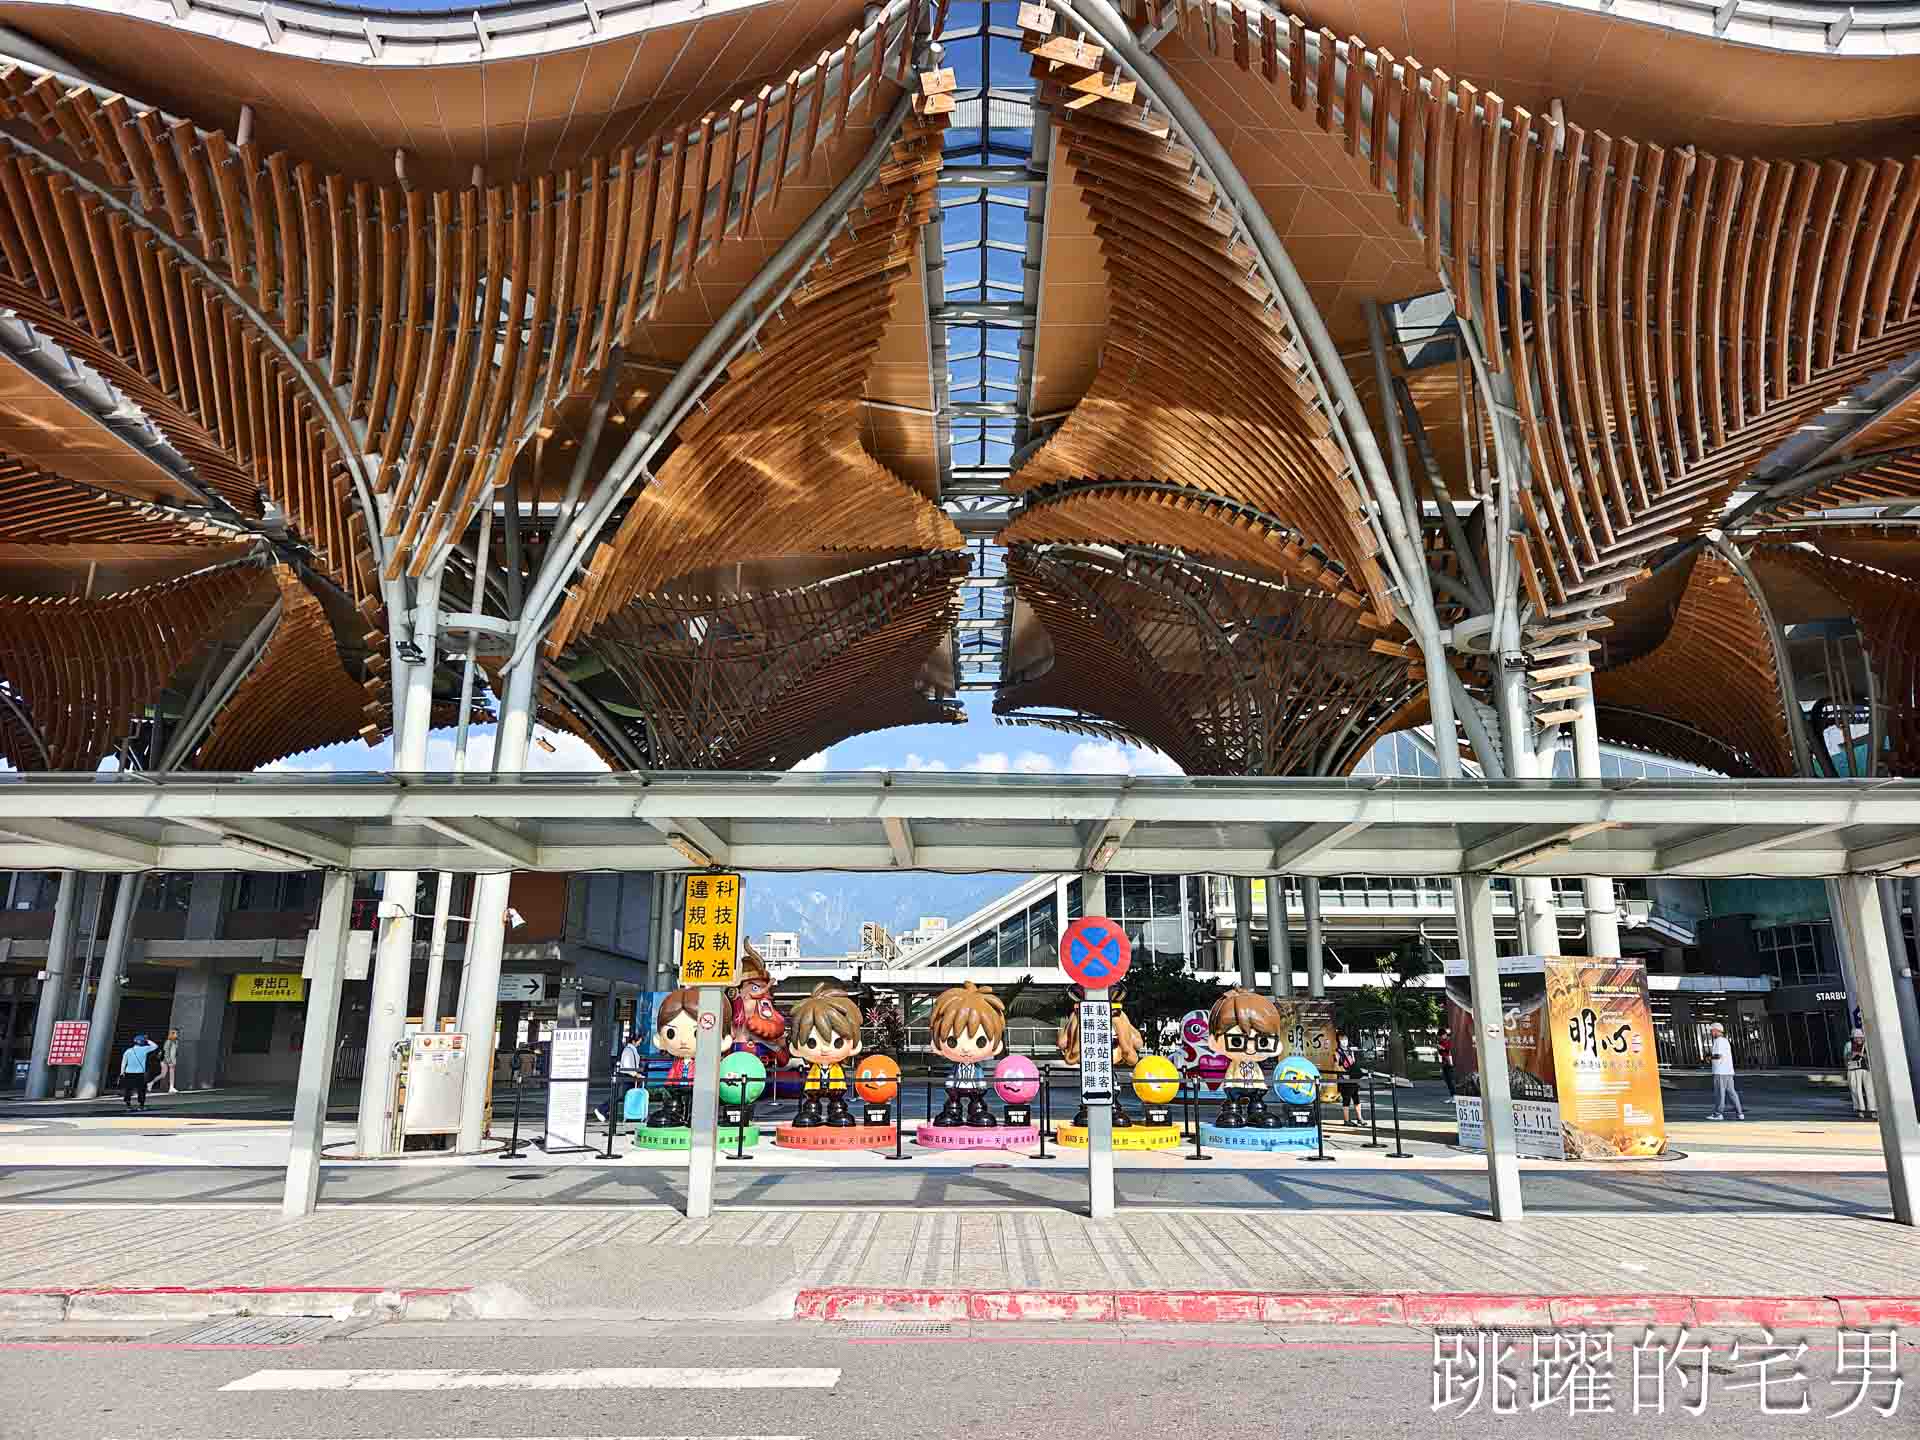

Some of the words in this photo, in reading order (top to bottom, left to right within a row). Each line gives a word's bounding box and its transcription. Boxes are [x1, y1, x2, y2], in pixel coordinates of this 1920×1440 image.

[685, 880, 709, 979] 違規取締
[711, 880, 735, 978] 科技執法
[253, 977, 289, 989] 東出口
[1816, 991, 1847, 1001] STARBU
[1082, 1004, 1096, 1089] 車輛即停即離
[1096, 1004, 1110, 1088] 載送離站乘客
